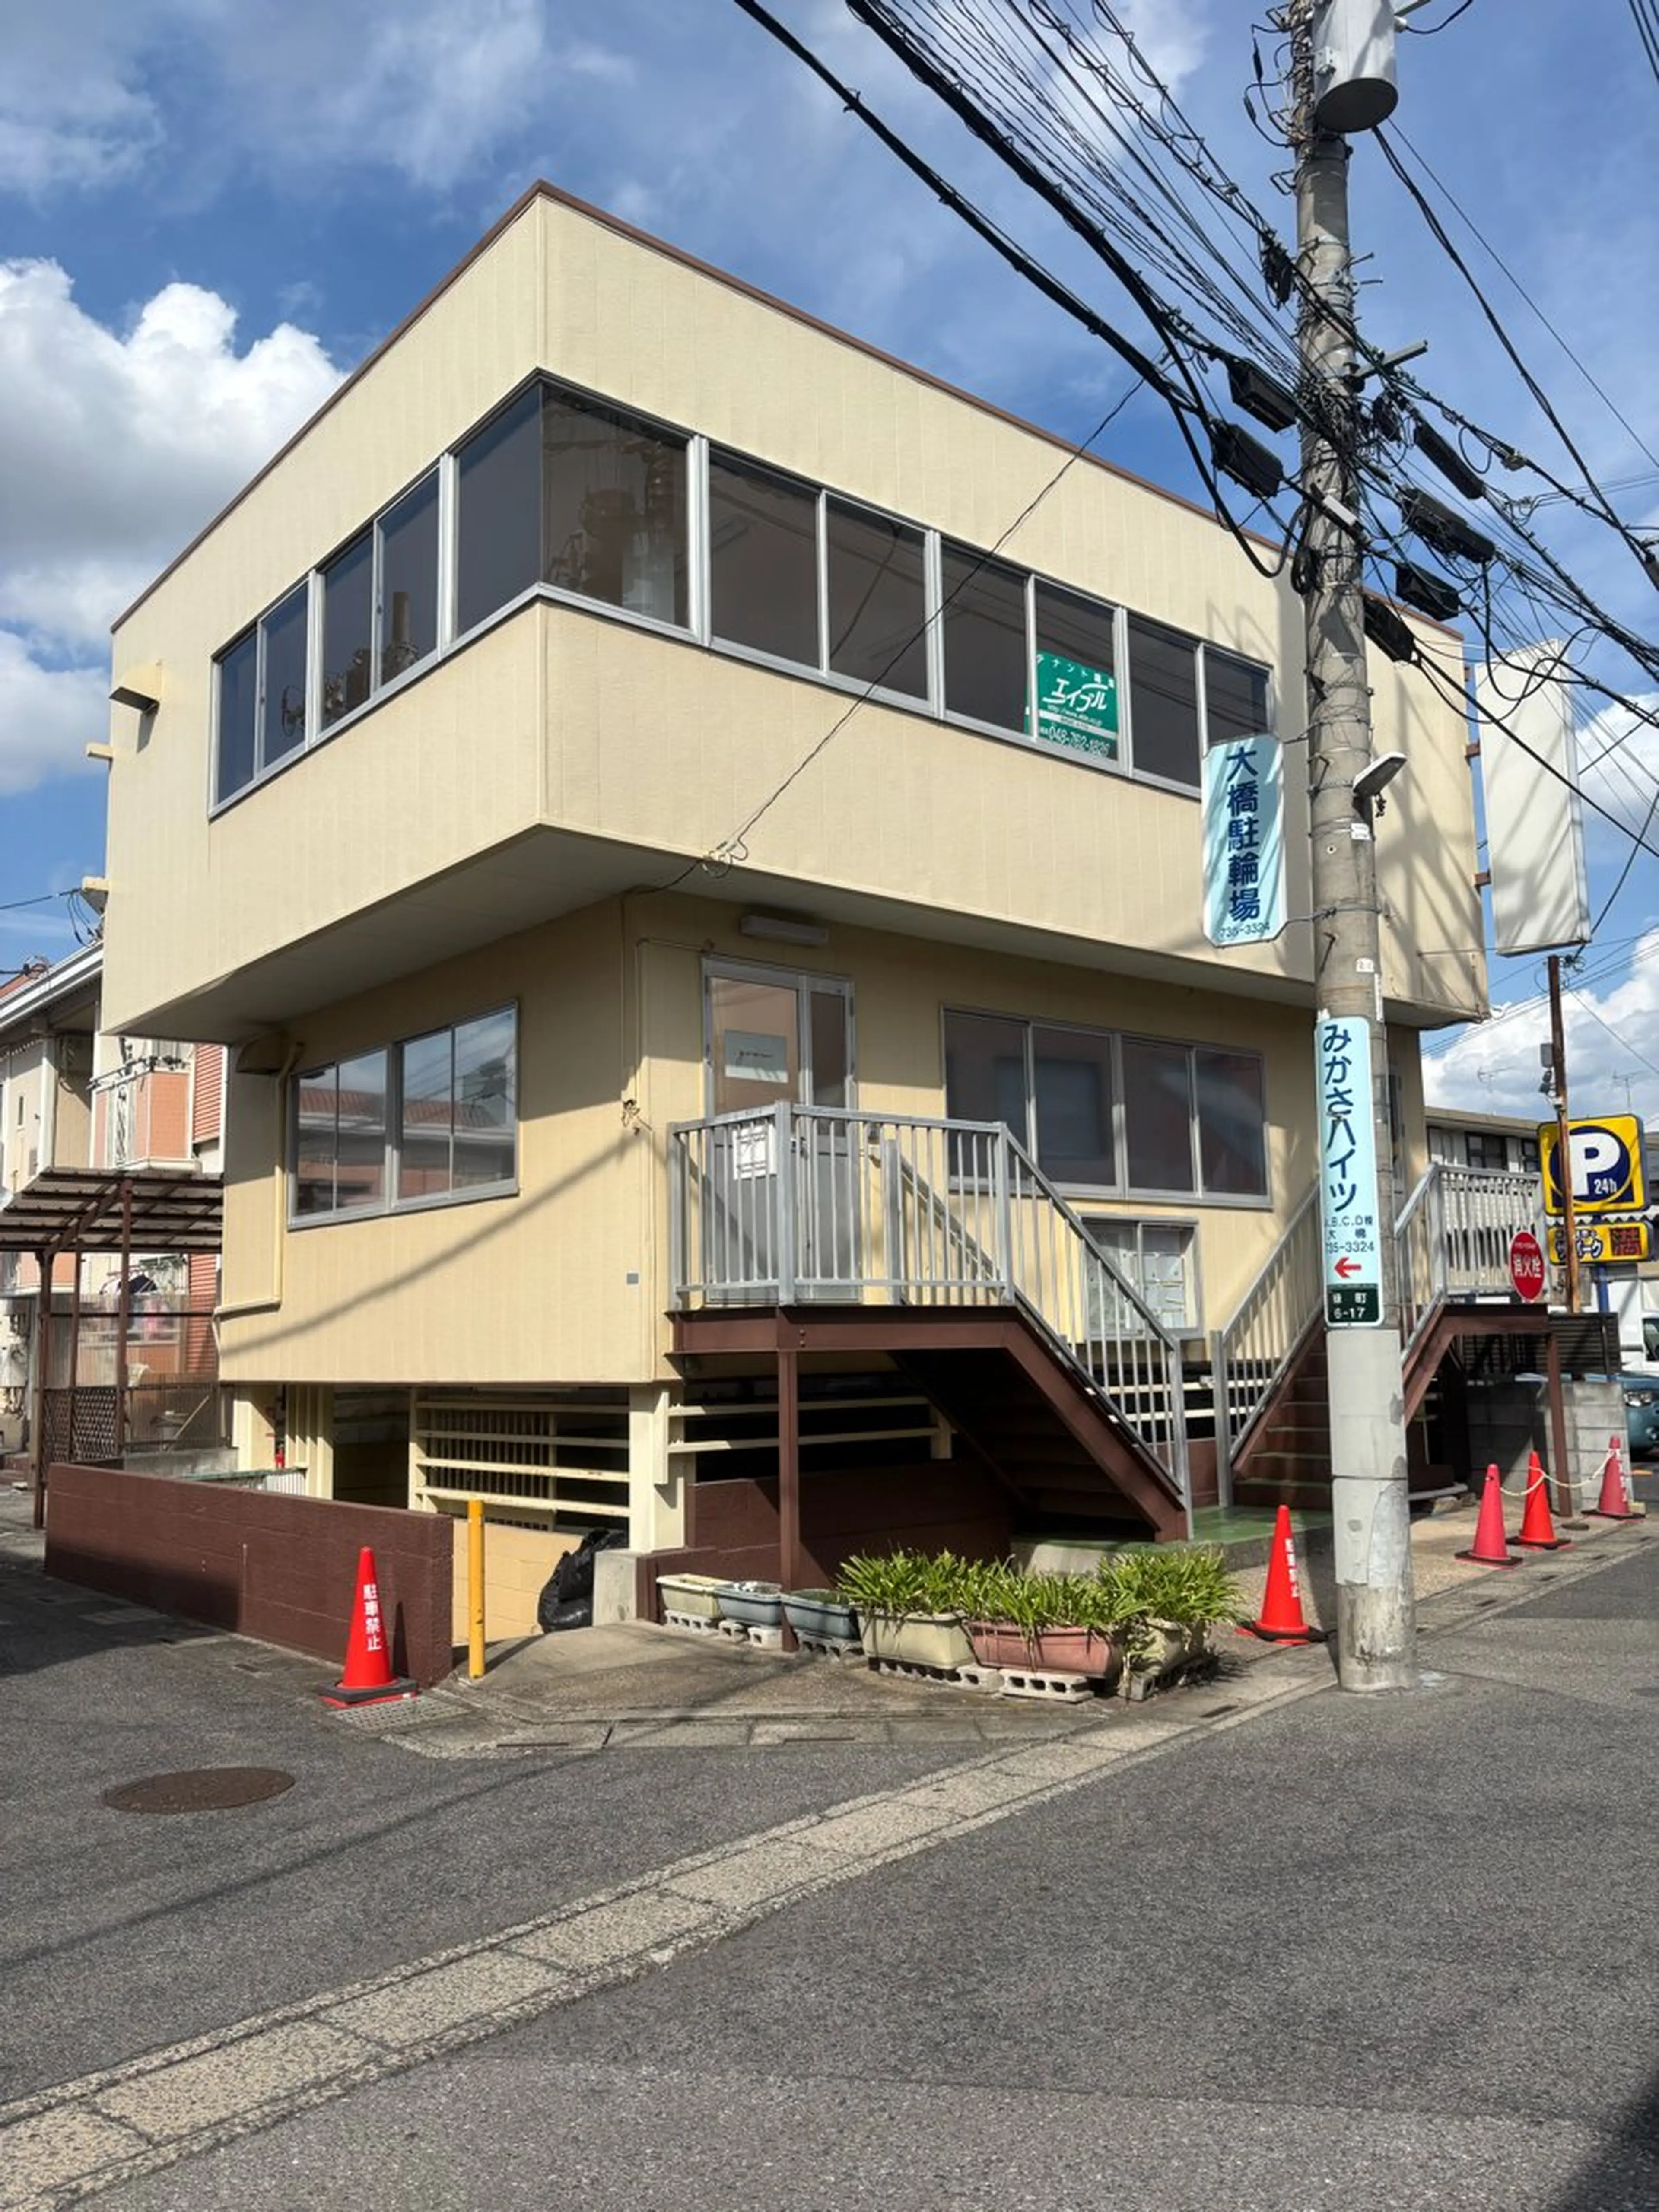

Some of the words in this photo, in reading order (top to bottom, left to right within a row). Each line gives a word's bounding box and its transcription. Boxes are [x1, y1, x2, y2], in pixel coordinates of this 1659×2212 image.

[1042, 677, 1109, 712] エイブル
[1227, 746, 1260, 922] 大橋駐輪場
[1323, 1024, 1357, 1212] みかさハイツ
[1569, 1132, 1621, 1196] P
[1594, 1177, 1617, 1195] 24h
